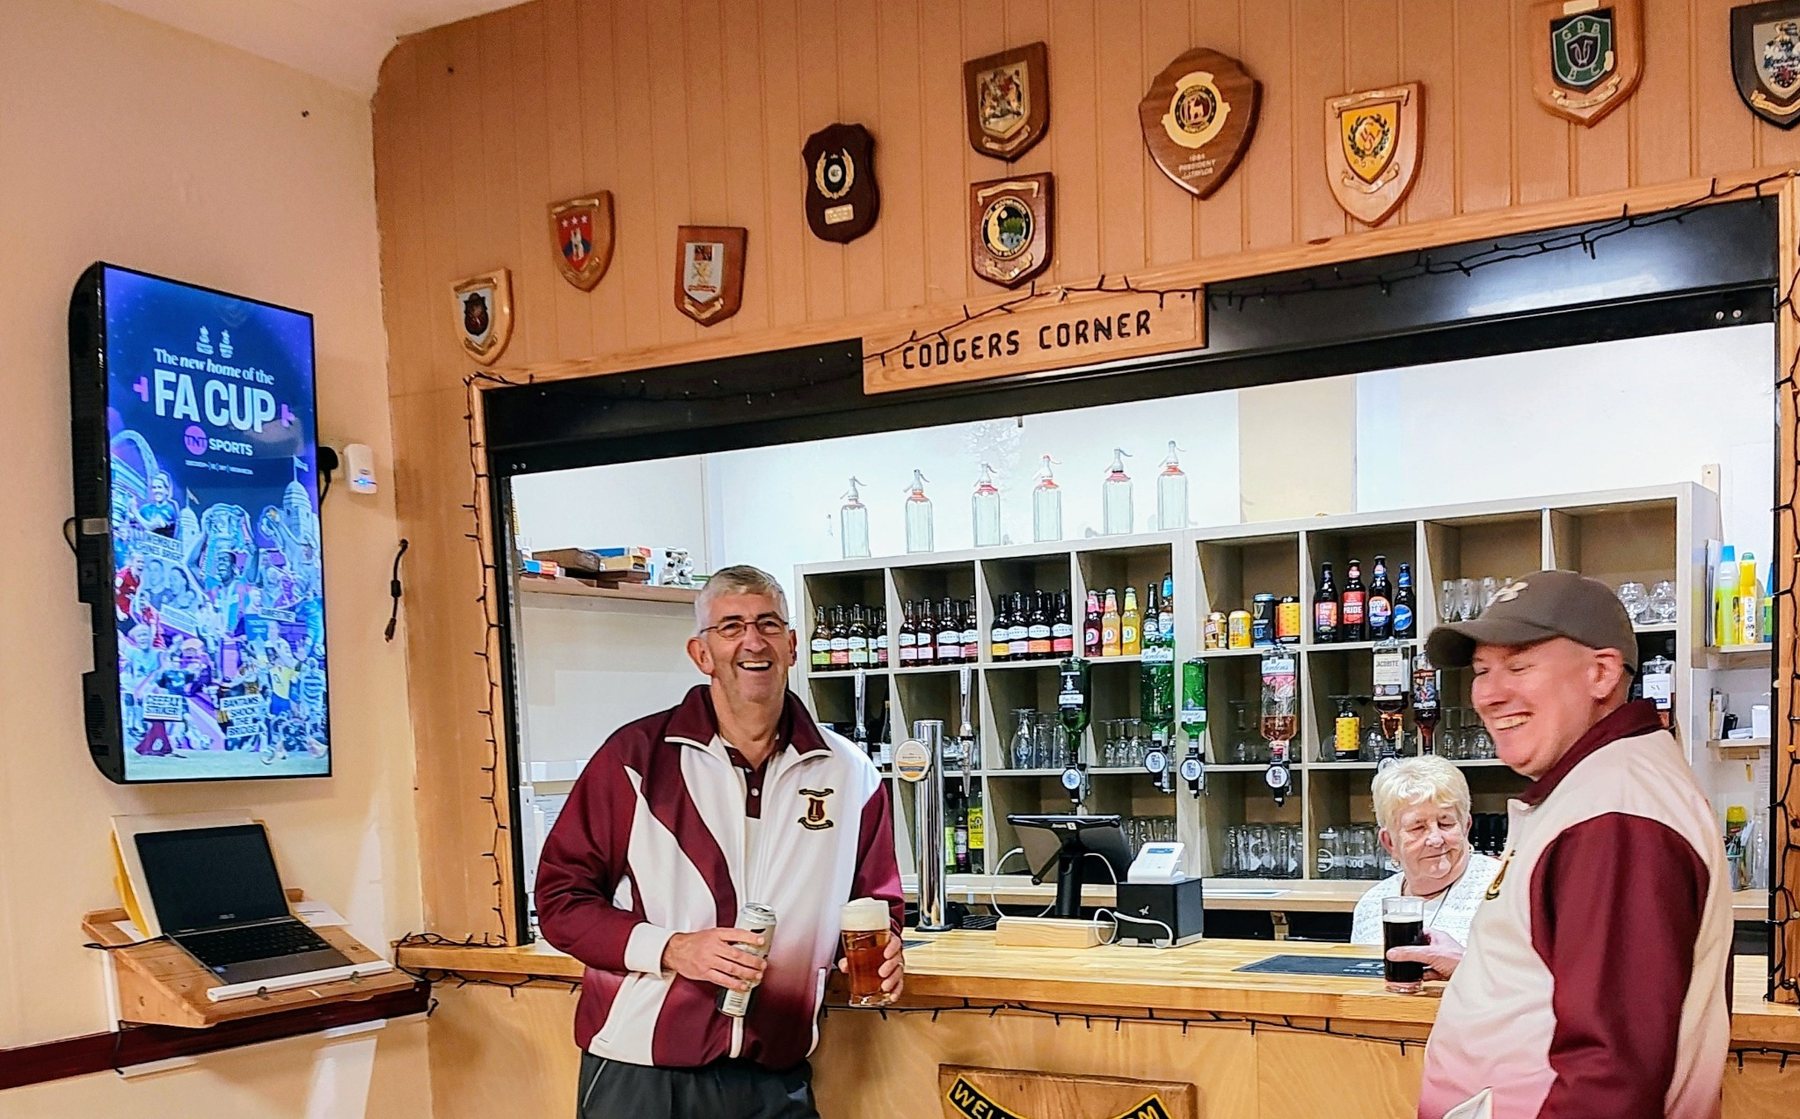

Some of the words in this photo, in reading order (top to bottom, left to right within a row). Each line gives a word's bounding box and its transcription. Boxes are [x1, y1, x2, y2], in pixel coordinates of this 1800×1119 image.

[902, 329, 1020, 369] CODGERS
[1039, 310, 1151, 350] CORNER
[153, 347, 179, 366] The
[180, 356, 206, 371] new
[206, 359, 241, 378] home
[242, 367, 256, 381] of
[255, 369, 275, 385] the
[154, 368, 200, 423] FA
[204, 379, 276, 433] CUP
[208, 437, 254, 456] SPORTS
